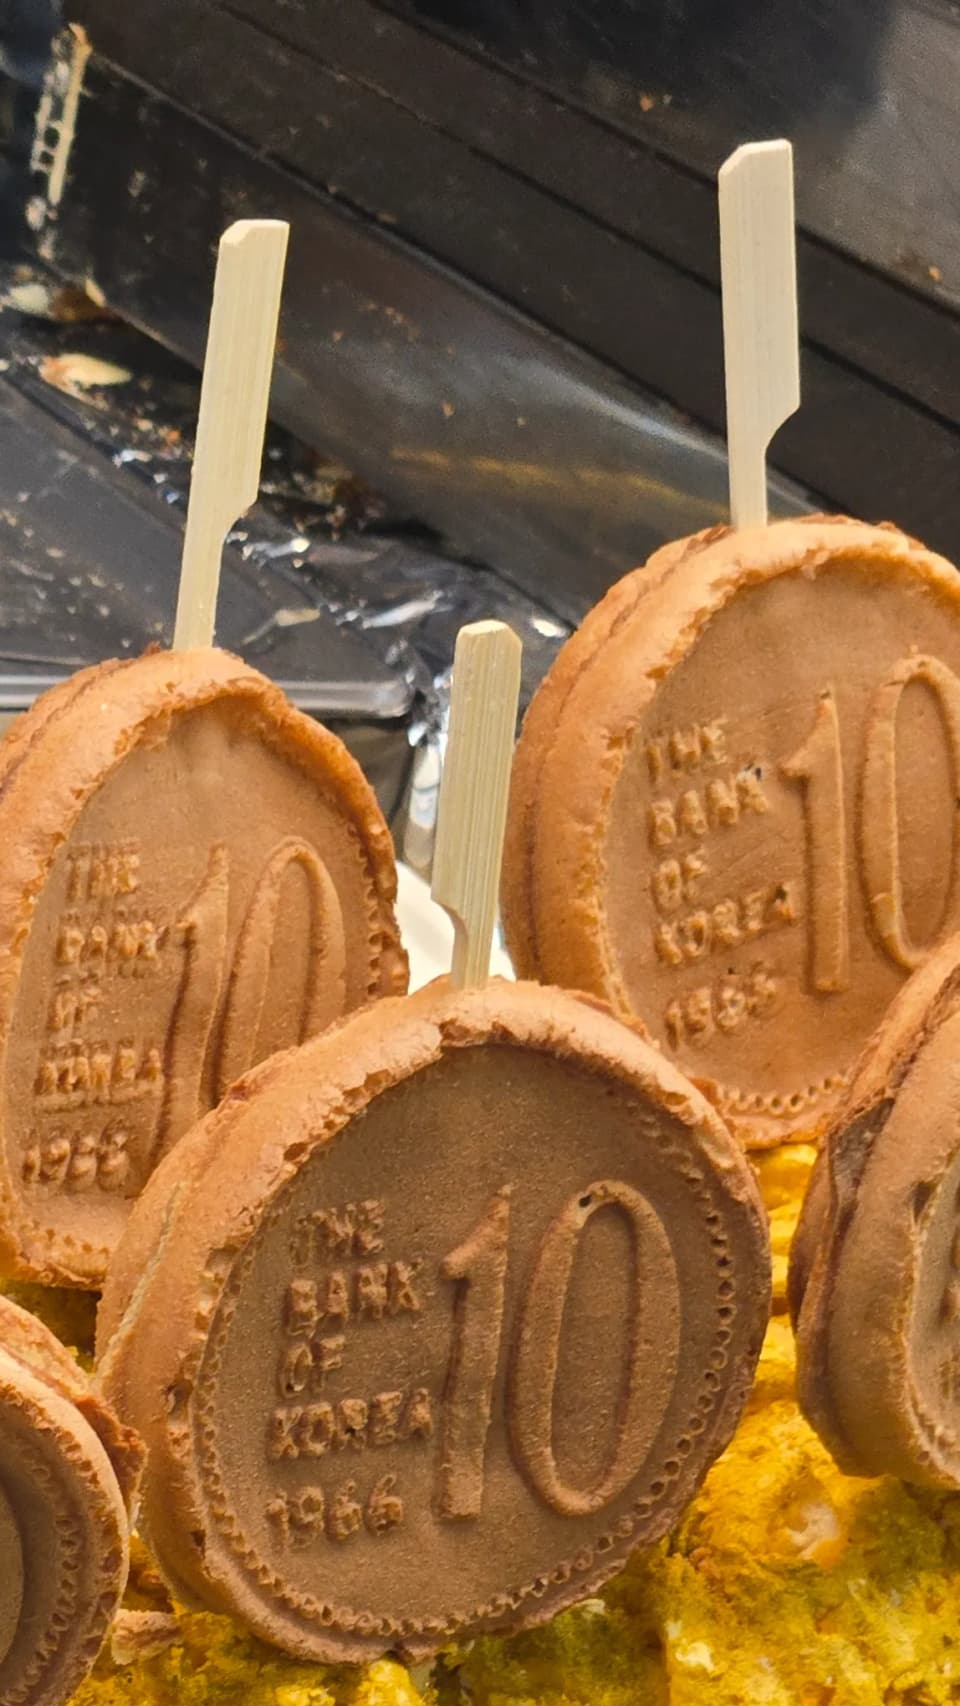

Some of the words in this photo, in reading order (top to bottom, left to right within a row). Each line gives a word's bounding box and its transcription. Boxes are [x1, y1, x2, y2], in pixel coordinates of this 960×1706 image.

[646, 717, 729, 783] THE
[649, 762, 770, 848] BANK
[778, 650, 960, 994] 10
[62, 845, 139, 900] THE
[651, 847, 708, 908] OF
[653, 882, 798, 966] KOREA
[148, 836, 347, 1165] 10
[290, 1200, 384, 1267] THE
[285, 1258, 422, 1337] BANK
[279, 1333, 346, 1399] OF
[441, 1181, 681, 1521] 10
[270, 1387, 435, 1460] KOREA
[267, 1473, 404, 1553] 1966
